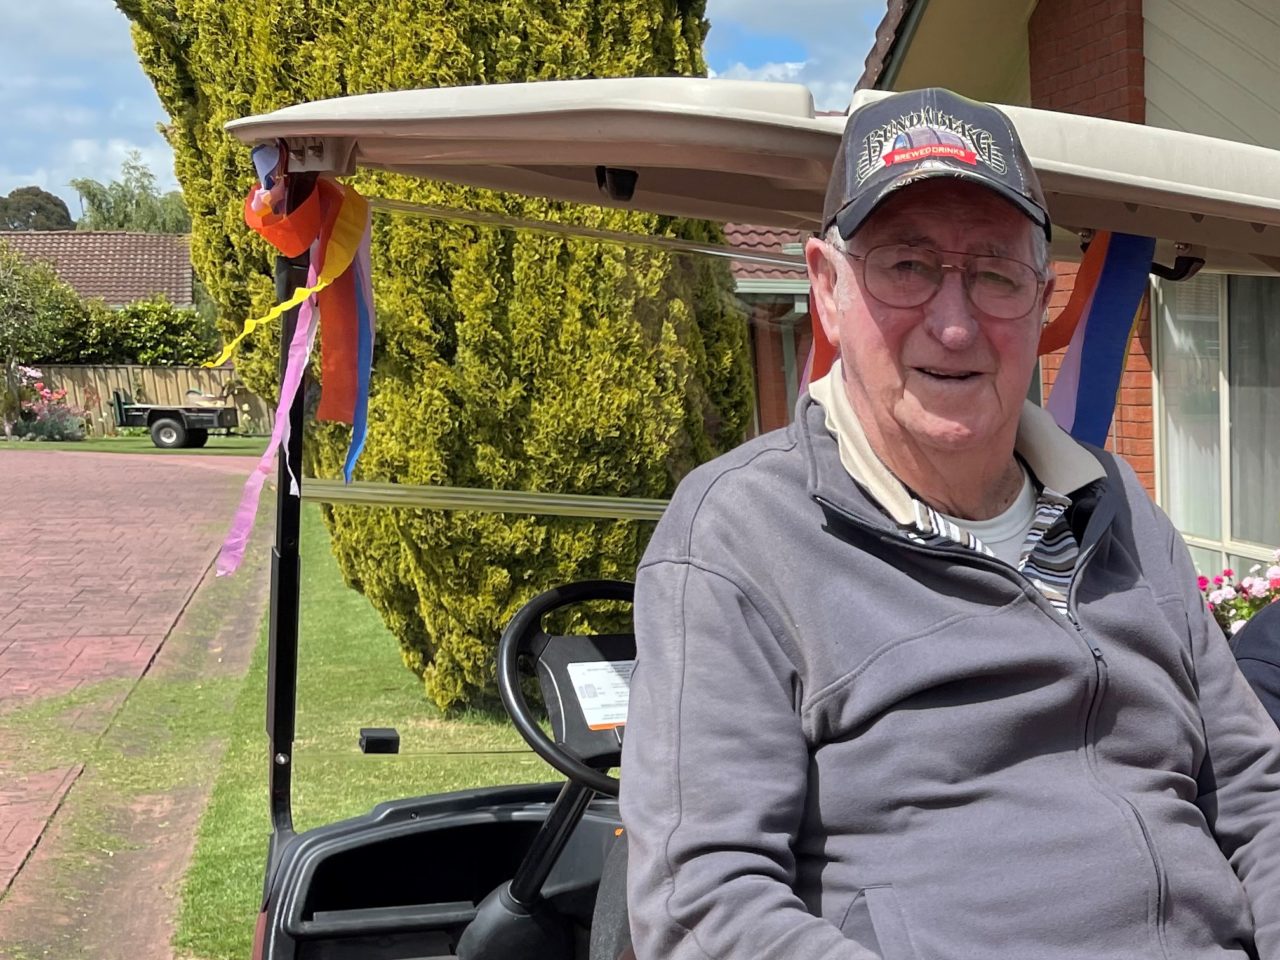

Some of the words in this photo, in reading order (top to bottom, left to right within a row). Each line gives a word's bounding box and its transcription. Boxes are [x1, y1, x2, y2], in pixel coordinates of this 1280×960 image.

[862, 105, 995, 168] BUNDABERG
[894, 147, 931, 160] BREWED
[931, 146, 965, 157] DRINKS
